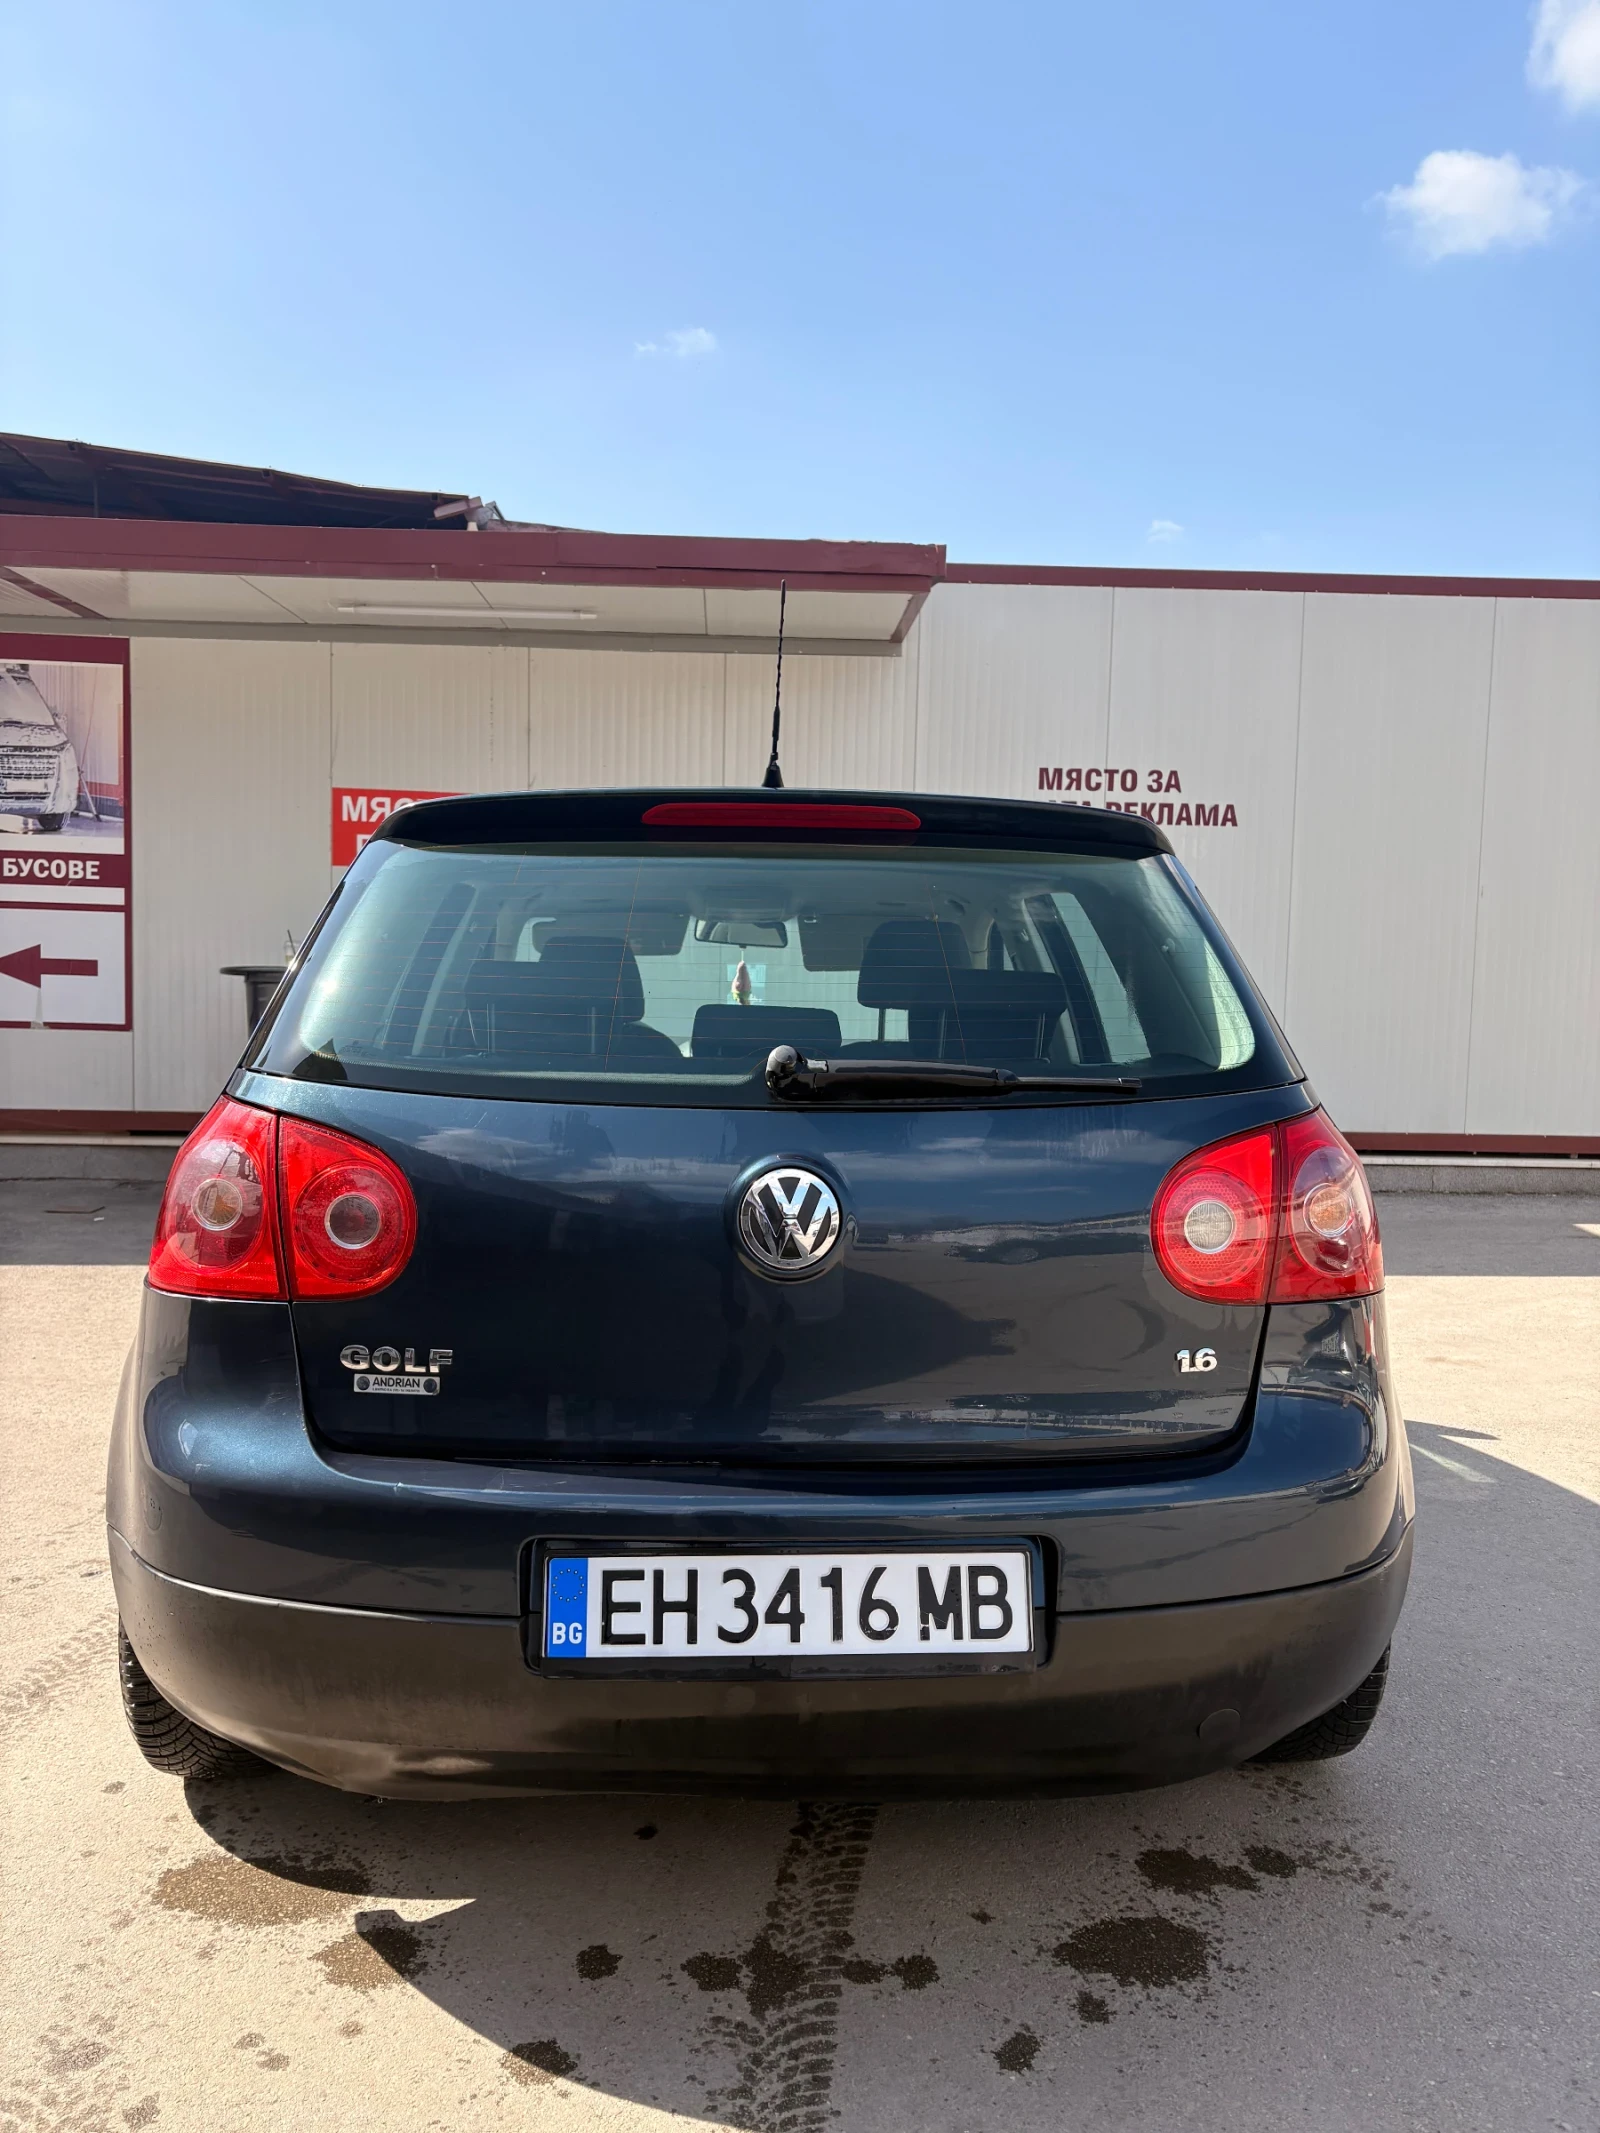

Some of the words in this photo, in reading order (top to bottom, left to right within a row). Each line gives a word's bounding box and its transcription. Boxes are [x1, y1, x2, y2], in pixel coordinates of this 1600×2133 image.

[1038, 767, 1138, 793] МЯСТО
[1146, 769, 1182, 793] ЗА
[2, 857, 100, 880] БУСОВЕ
[339, 1344, 453, 1373] GOLF
[372, 1376, 421, 1389] ANDRIAN
[600, 1568, 699, 1646] EH
[717, 1565, 900, 1644] 3416
[918, 1564, 1013, 1641] MB
[552, 1621, 583, 1646] BG
